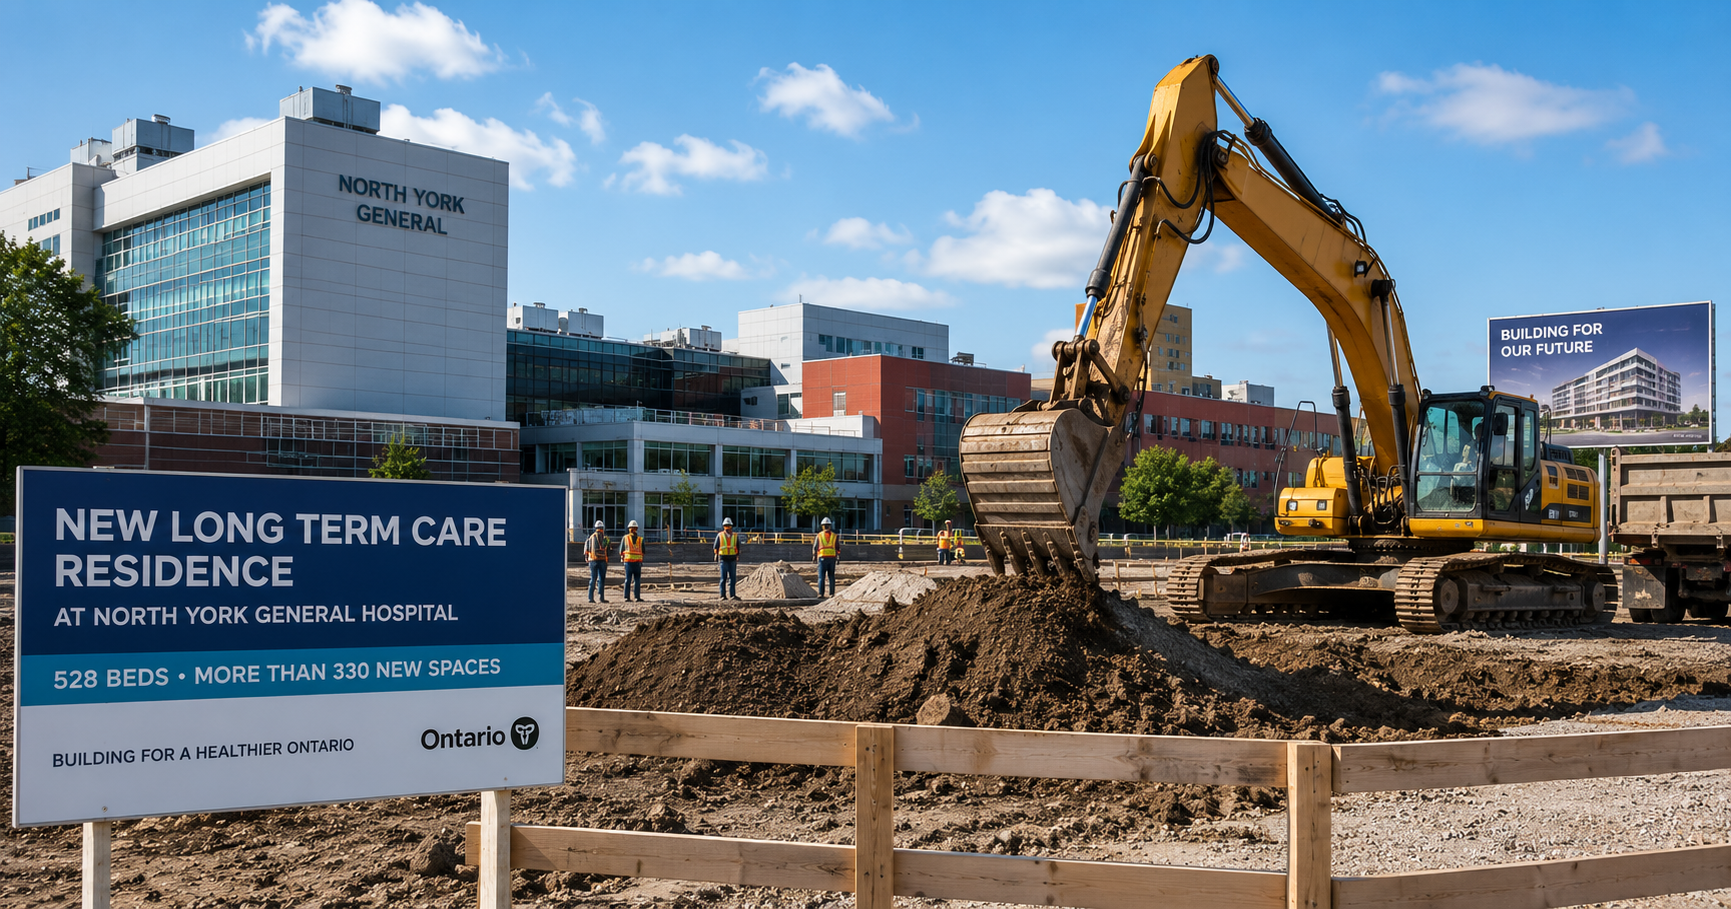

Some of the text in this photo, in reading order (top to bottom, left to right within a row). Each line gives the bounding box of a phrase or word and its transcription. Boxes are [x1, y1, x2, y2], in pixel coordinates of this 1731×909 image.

[339, 174, 465, 214] NORTH YORK
[356, 203, 448, 236] GENERAL
[1502, 323, 1603, 340] BUILDING FOR
[1501, 341, 1593, 357] OUR FUTURE
[55, 507, 507, 547] NEW LONG TERM CARE
[55, 554, 294, 588] RESIDENCE
[53, 604, 459, 627] AT NORTH YORK GENERAL HOSPITAL
[53, 658, 501, 690] 528 BEDS MORE THAN 330 NEW SPACES
[52, 738, 355, 768] BUILDING FOR A HEALTHIER ONTARIO
[420, 725, 506, 751] Ontario
